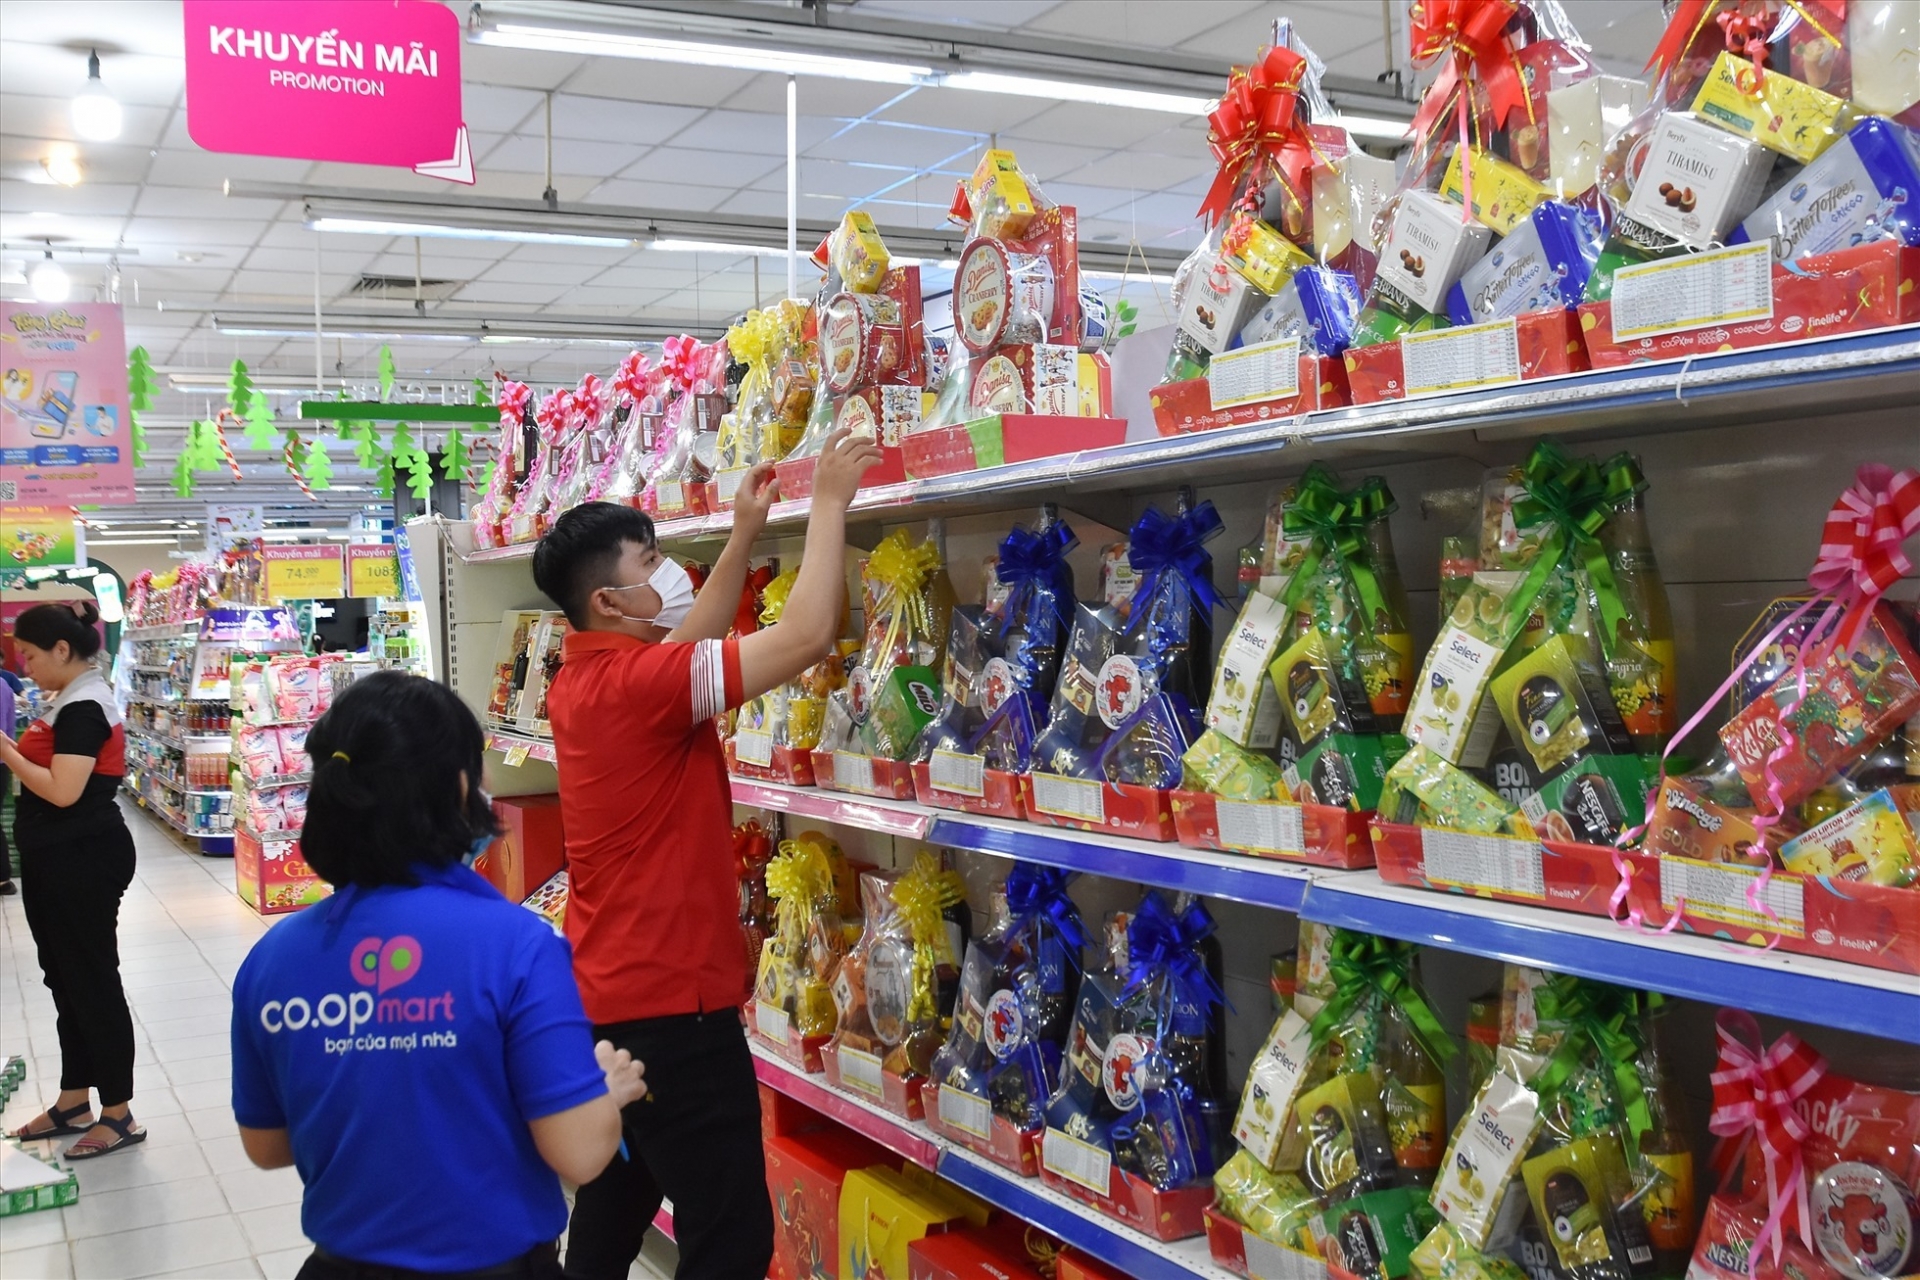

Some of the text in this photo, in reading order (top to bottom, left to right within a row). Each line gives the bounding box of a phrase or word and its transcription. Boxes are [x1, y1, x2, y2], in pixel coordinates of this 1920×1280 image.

[209, 25, 438, 77] KHUYẾN MÃI
[270, 70, 385, 97] PROMOTION
[1666, 149, 1718, 181] TIRAMISU
[1406, 222, 1441, 254] TIRAMISU
[966, 261, 997, 294] Danisa
[969, 286, 998, 304] CRANBERRY
[1808, 312, 1842, 328] finelife
[266, 548, 303, 560] Khuyến
[351, 548, 386, 559] Khuyến
[1239, 627, 1268, 650] Select
[1450, 640, 1479, 664] Select
[911, 683, 935, 713] MILO
[1735, 713, 1779, 768] KitKat
[1666, 787, 1723, 832] Vinacafé
[1660, 825, 1703, 859] GOLD
[1800, 832, 1818, 846] TRAO
[1817, 816, 1844, 834] LIPTON
[355, 1032, 387, 1051] của
[390, 1032, 417, 1053] mọi
[421, 1030, 457, 1049] nhà
[1270, 1045, 1298, 1075] Select
[1477, 1111, 1515, 1151] Select
[1797, 1097, 1861, 1150] OCKY
[1707, 1240, 1750, 1275] NESTE
